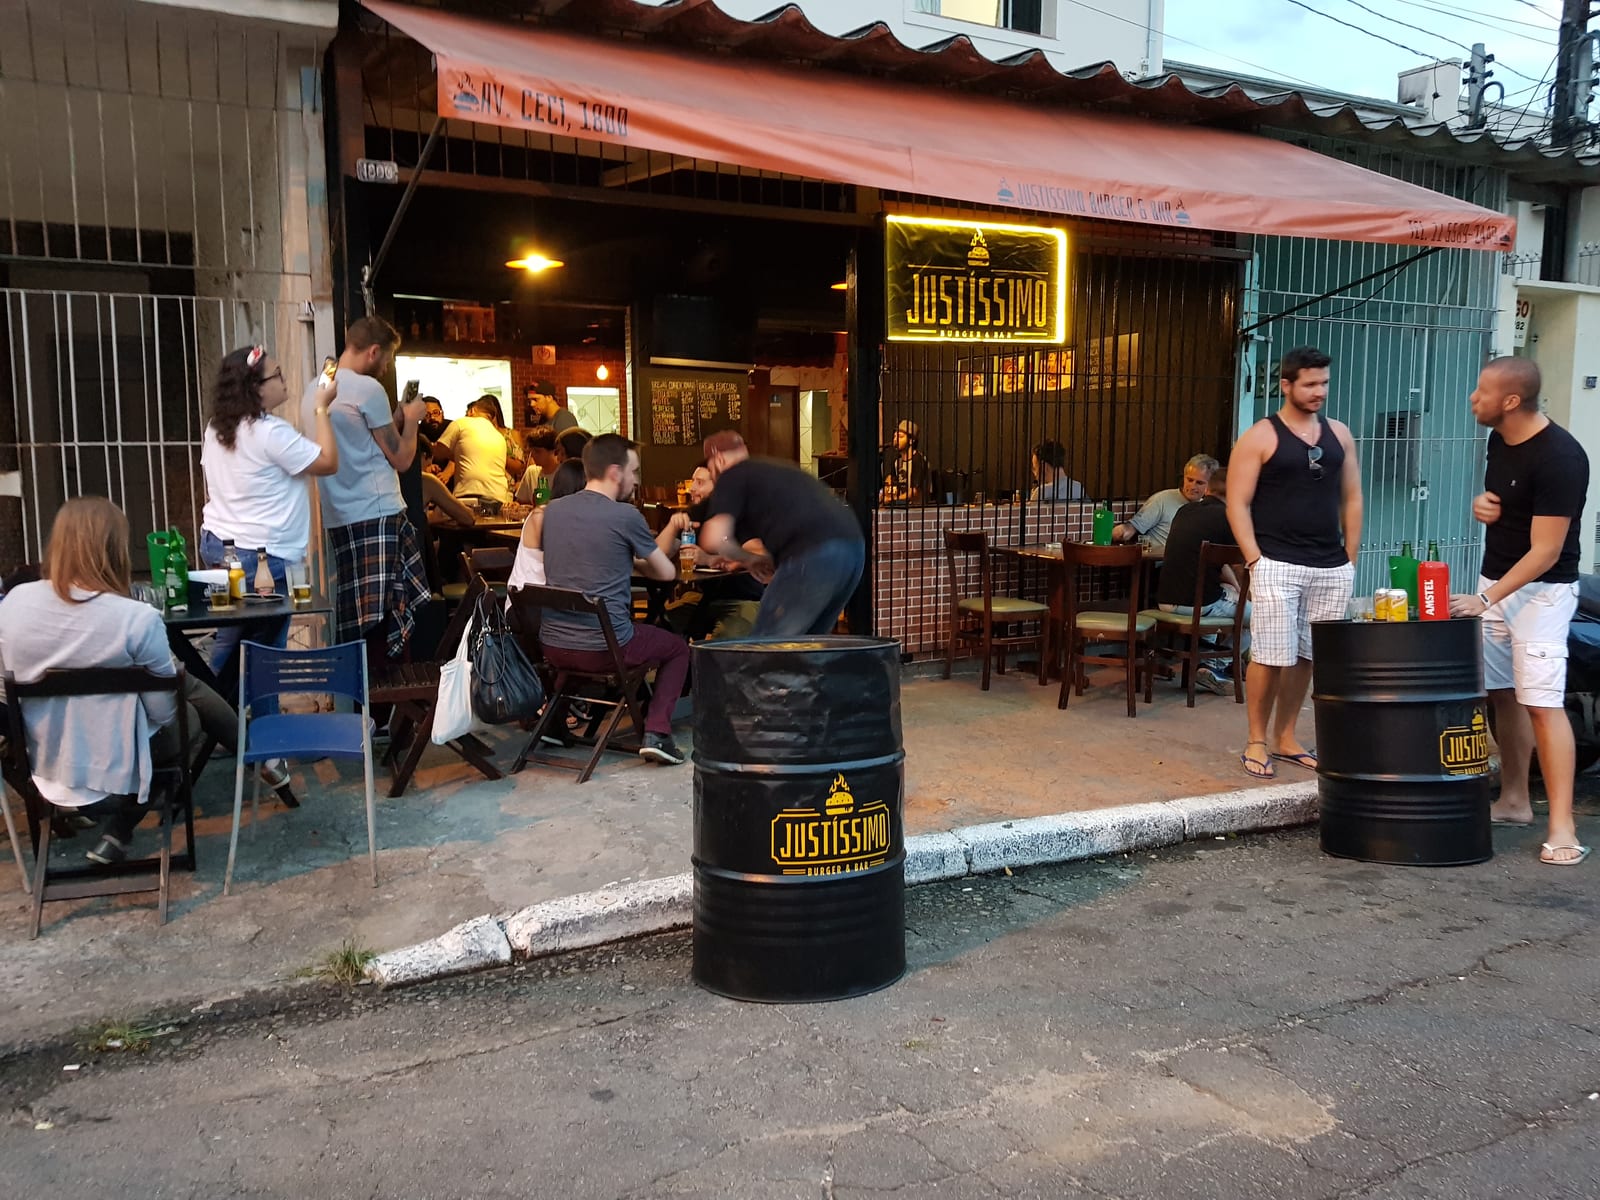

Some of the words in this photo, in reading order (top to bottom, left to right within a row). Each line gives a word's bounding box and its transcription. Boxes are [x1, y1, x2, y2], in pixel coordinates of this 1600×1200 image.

[481, 82, 511, 119] AV.
[521, 88, 571, 132] CECI,
[578, 101, 628, 137] 1800
[1088, 191, 1136, 219] BURGER
[1150, 200, 1175, 223] BAR
[906, 271, 1048, 328] JUSTÍSSIMO
[940, 329, 981, 338] BURGER
[993, 331, 1012, 339] BAR
[1424, 579, 1435, 616] AMSTEL
[780, 813, 887, 857] JUSTÍSSIMO
[807, 865, 842, 877] BURGER
[845, 863, 851, 873] &
[854, 861, 869, 872] BAR
